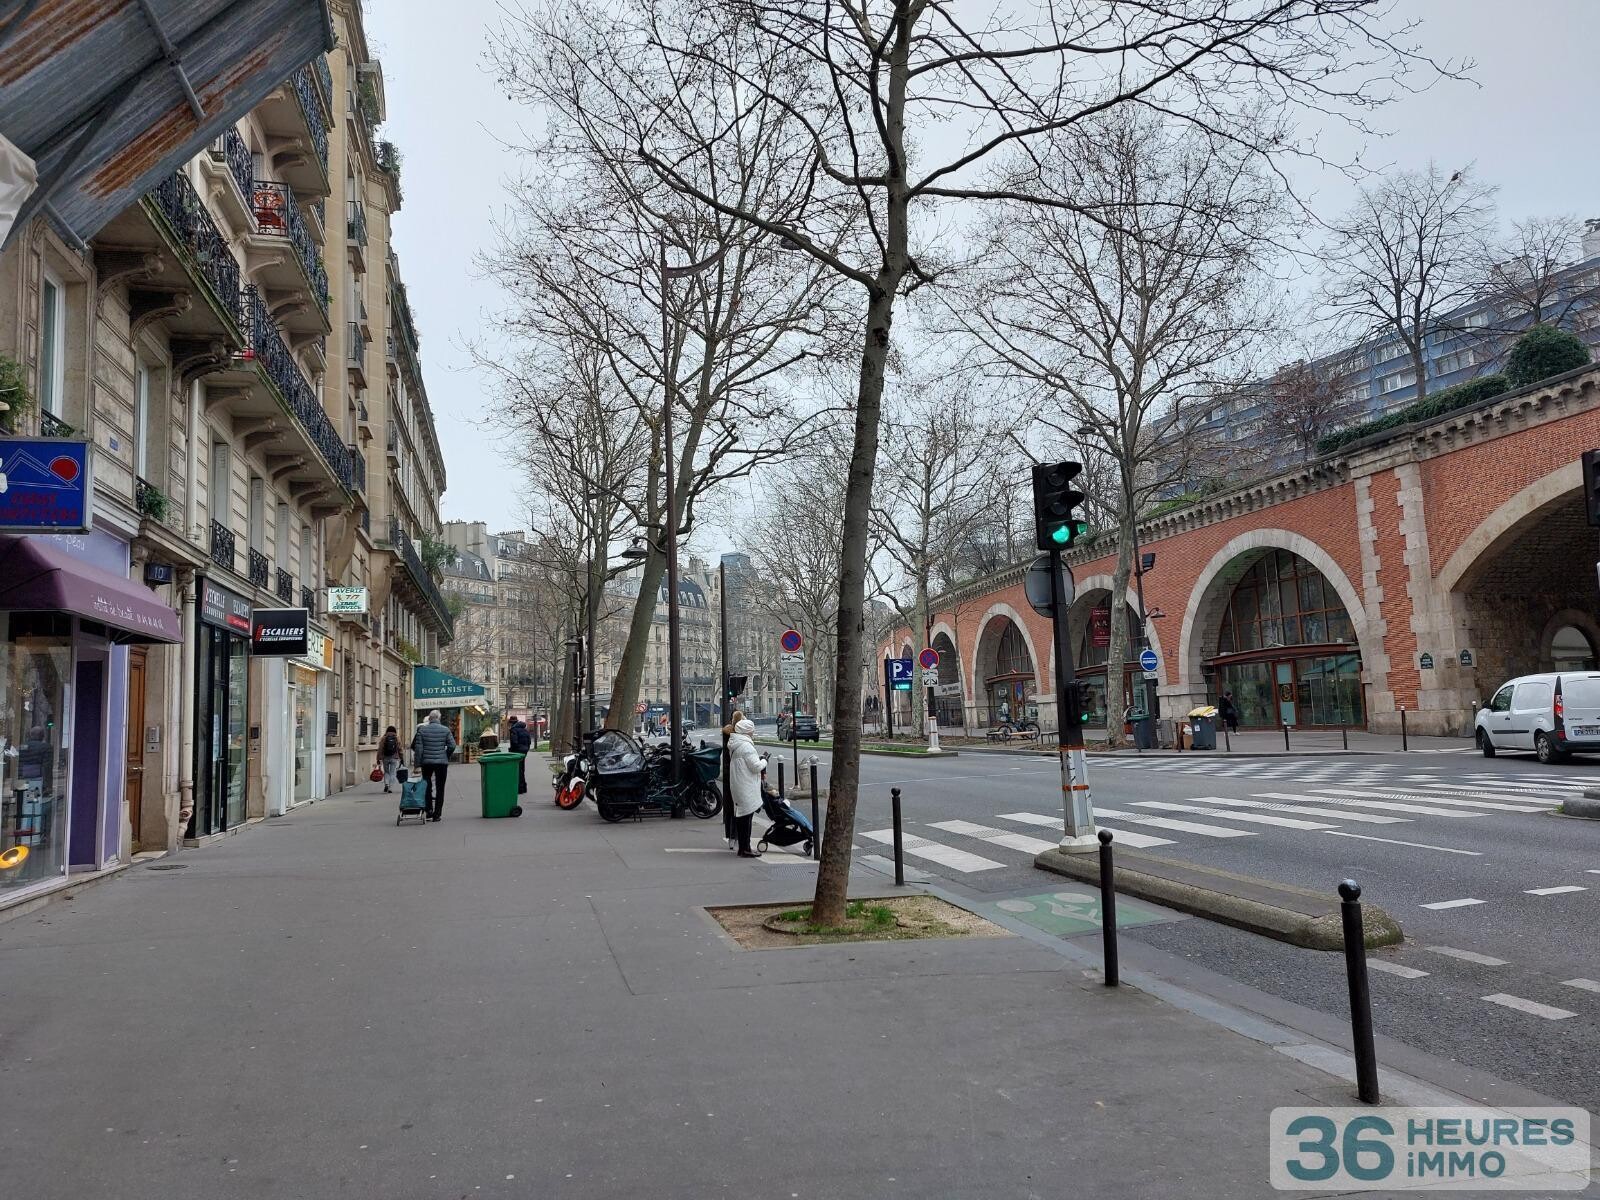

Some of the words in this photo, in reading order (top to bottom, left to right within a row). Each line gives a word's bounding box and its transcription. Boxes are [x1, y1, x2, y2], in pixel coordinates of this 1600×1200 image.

[154, 567, 164, 579] 10
[261, 627, 305, 636] ESCALIERS
[892, 662, 903, 678] P
[421, 685, 473, 695] BOTANISTE
